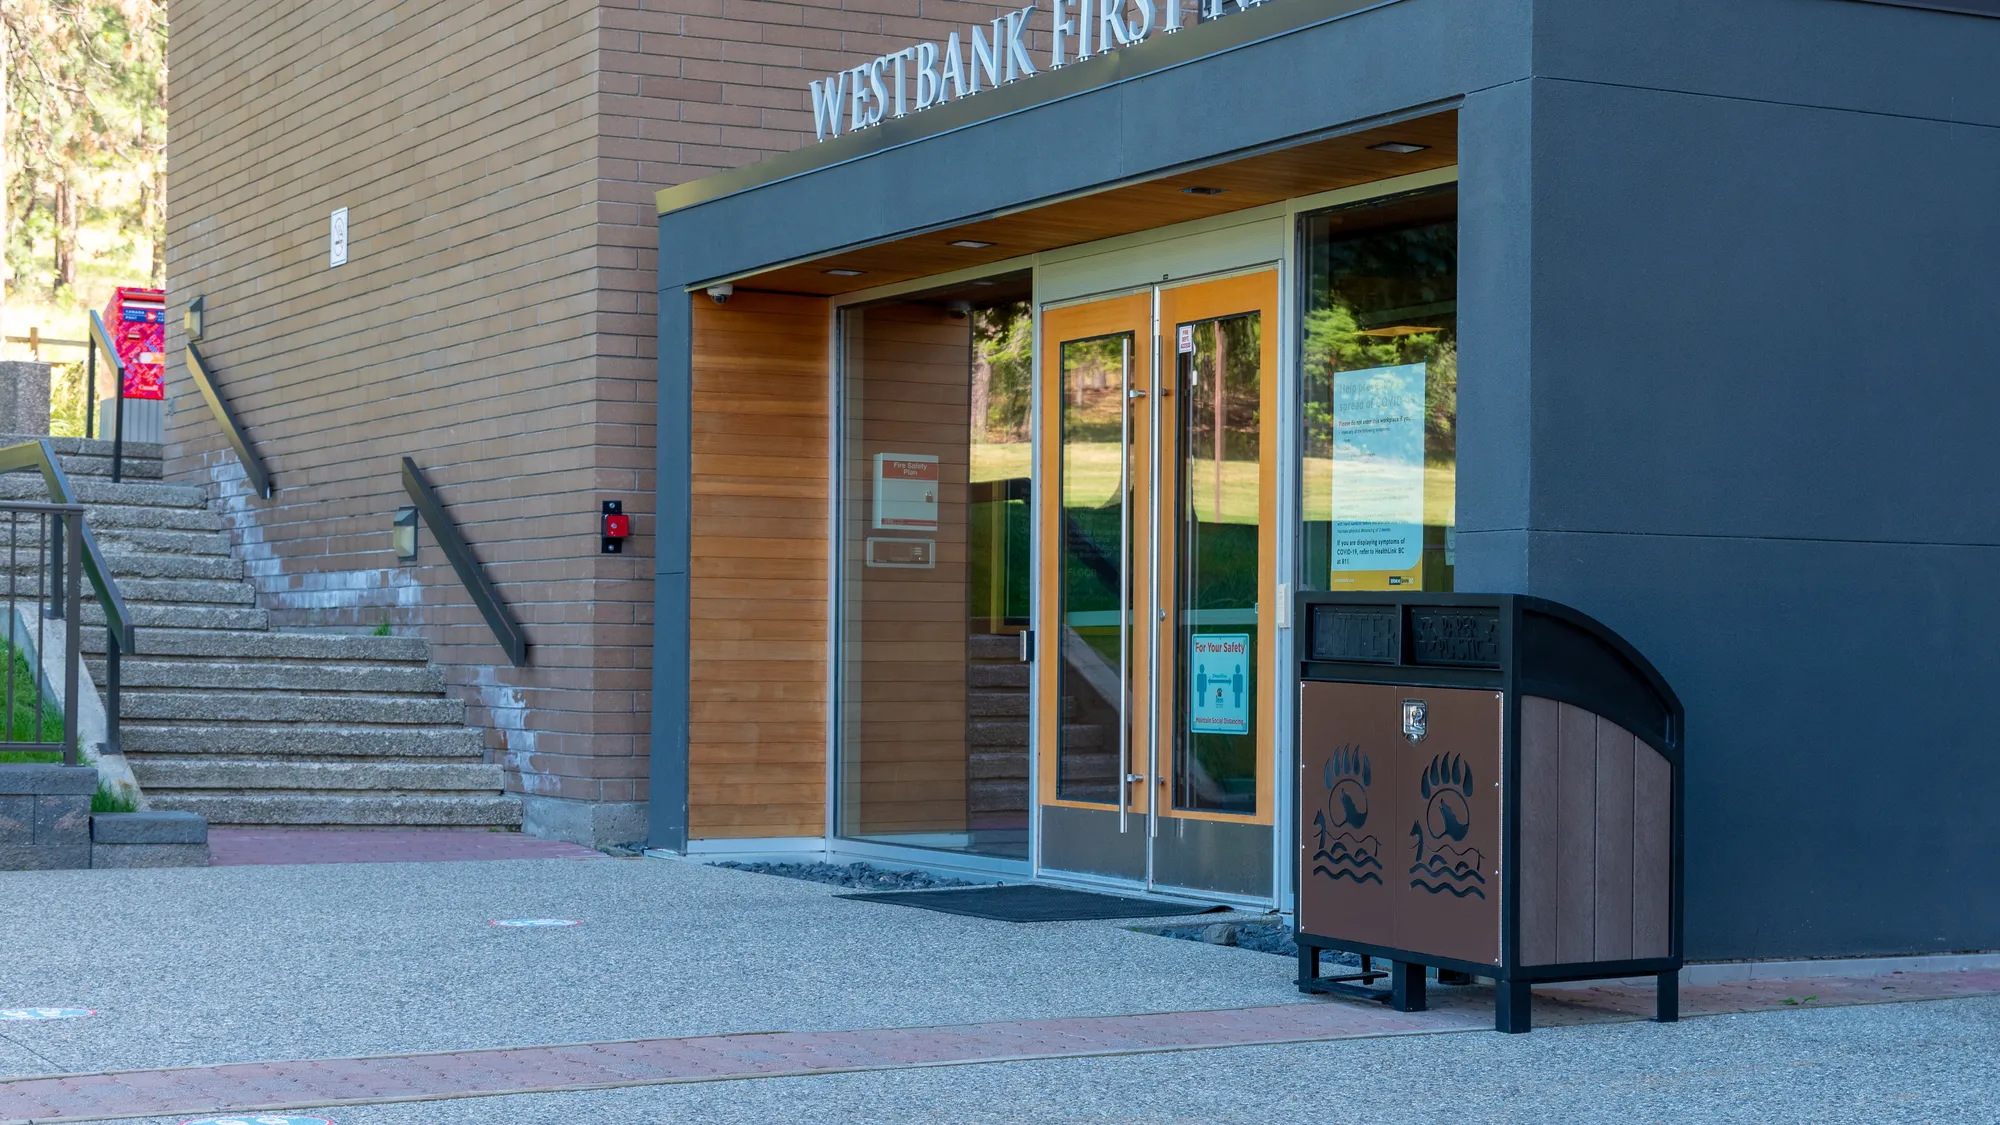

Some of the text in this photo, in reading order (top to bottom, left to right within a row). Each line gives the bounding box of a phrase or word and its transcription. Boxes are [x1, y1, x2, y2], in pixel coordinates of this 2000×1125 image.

[808, 5, 1040, 141] WESTBANK
[1340, 383, 1356, 395] Help
[1340, 400, 1364, 412] spread
[1366, 398, 1374, 409] of
[907, 462, 927, 471] Safety
[1195, 642, 1245, 654] For Your Safety
[1224, 718, 1244, 726] Distancing
